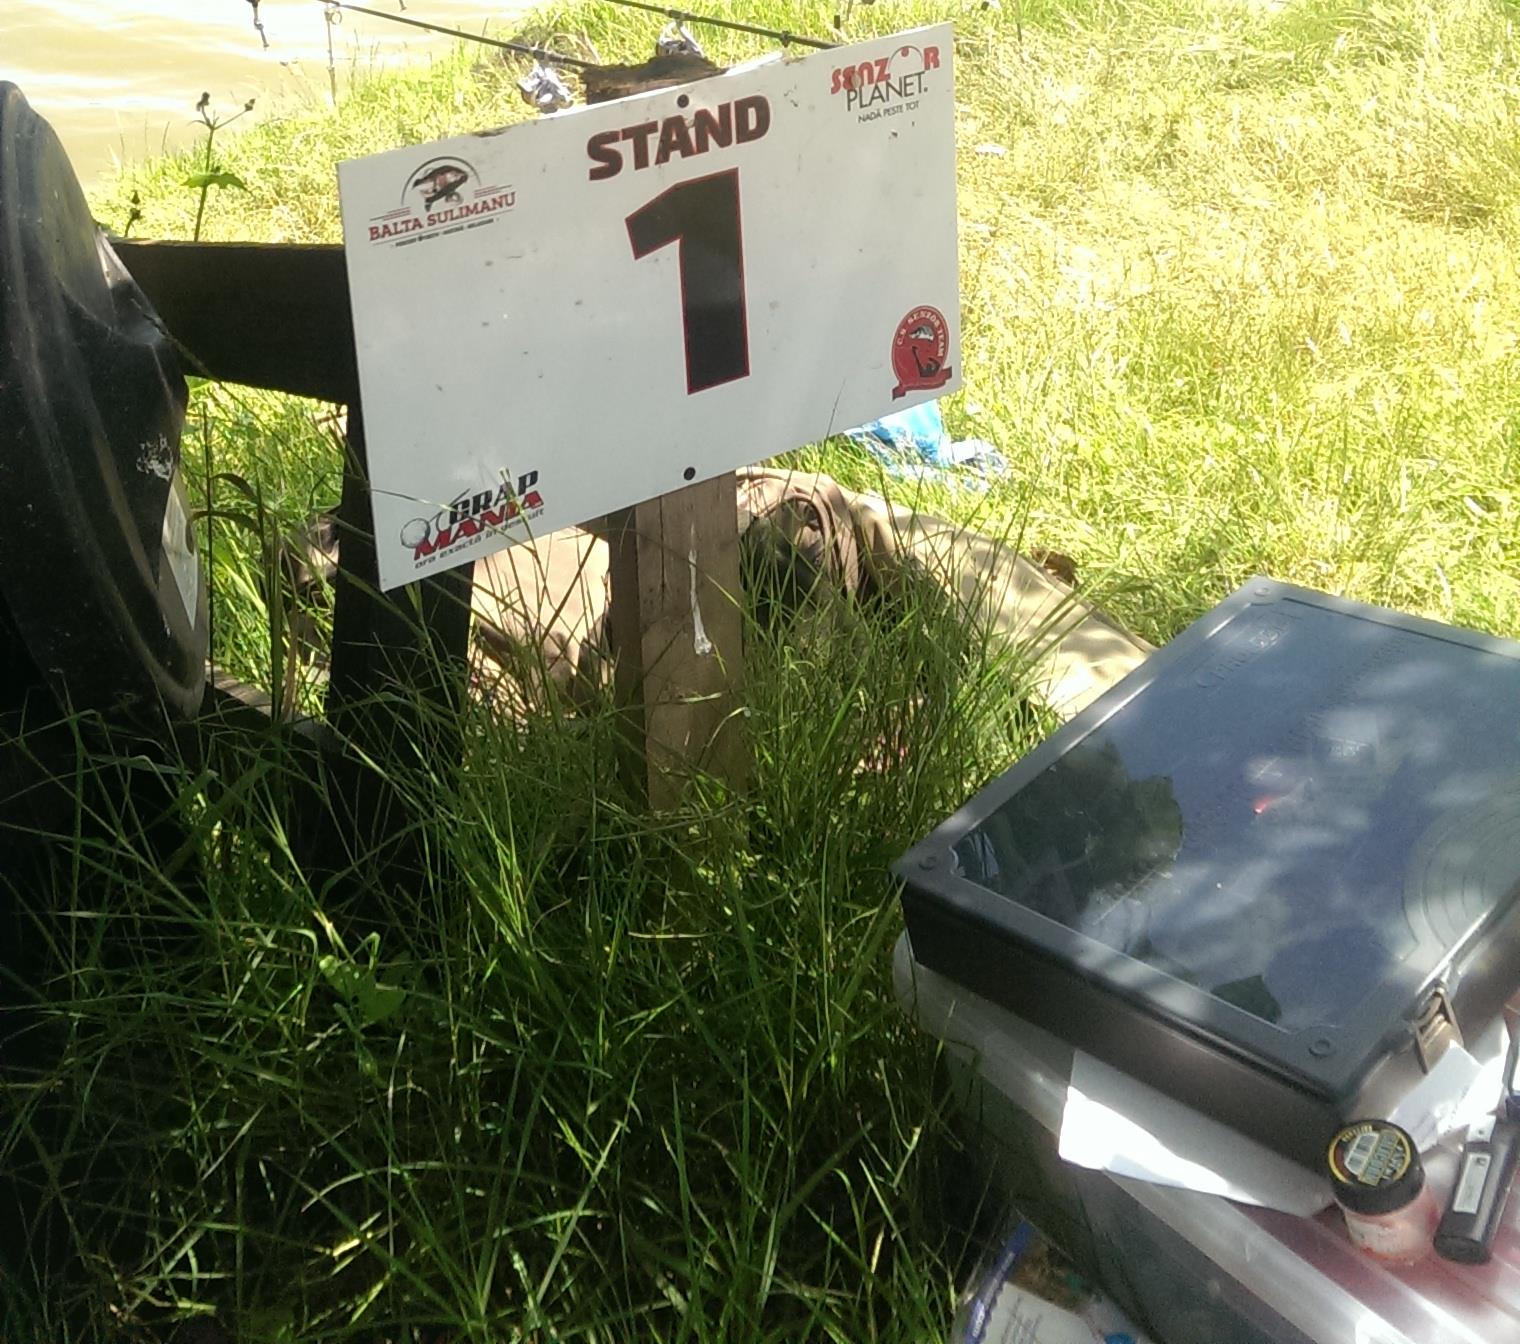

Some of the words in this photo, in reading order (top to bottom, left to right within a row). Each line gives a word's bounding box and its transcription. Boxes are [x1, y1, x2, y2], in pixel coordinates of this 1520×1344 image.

[587, 94, 771, 181] STAND
[368, 217, 423, 241] BALTA
[427, 192, 517, 227] SULIMANU
[625, 167, 750, 395] 1
